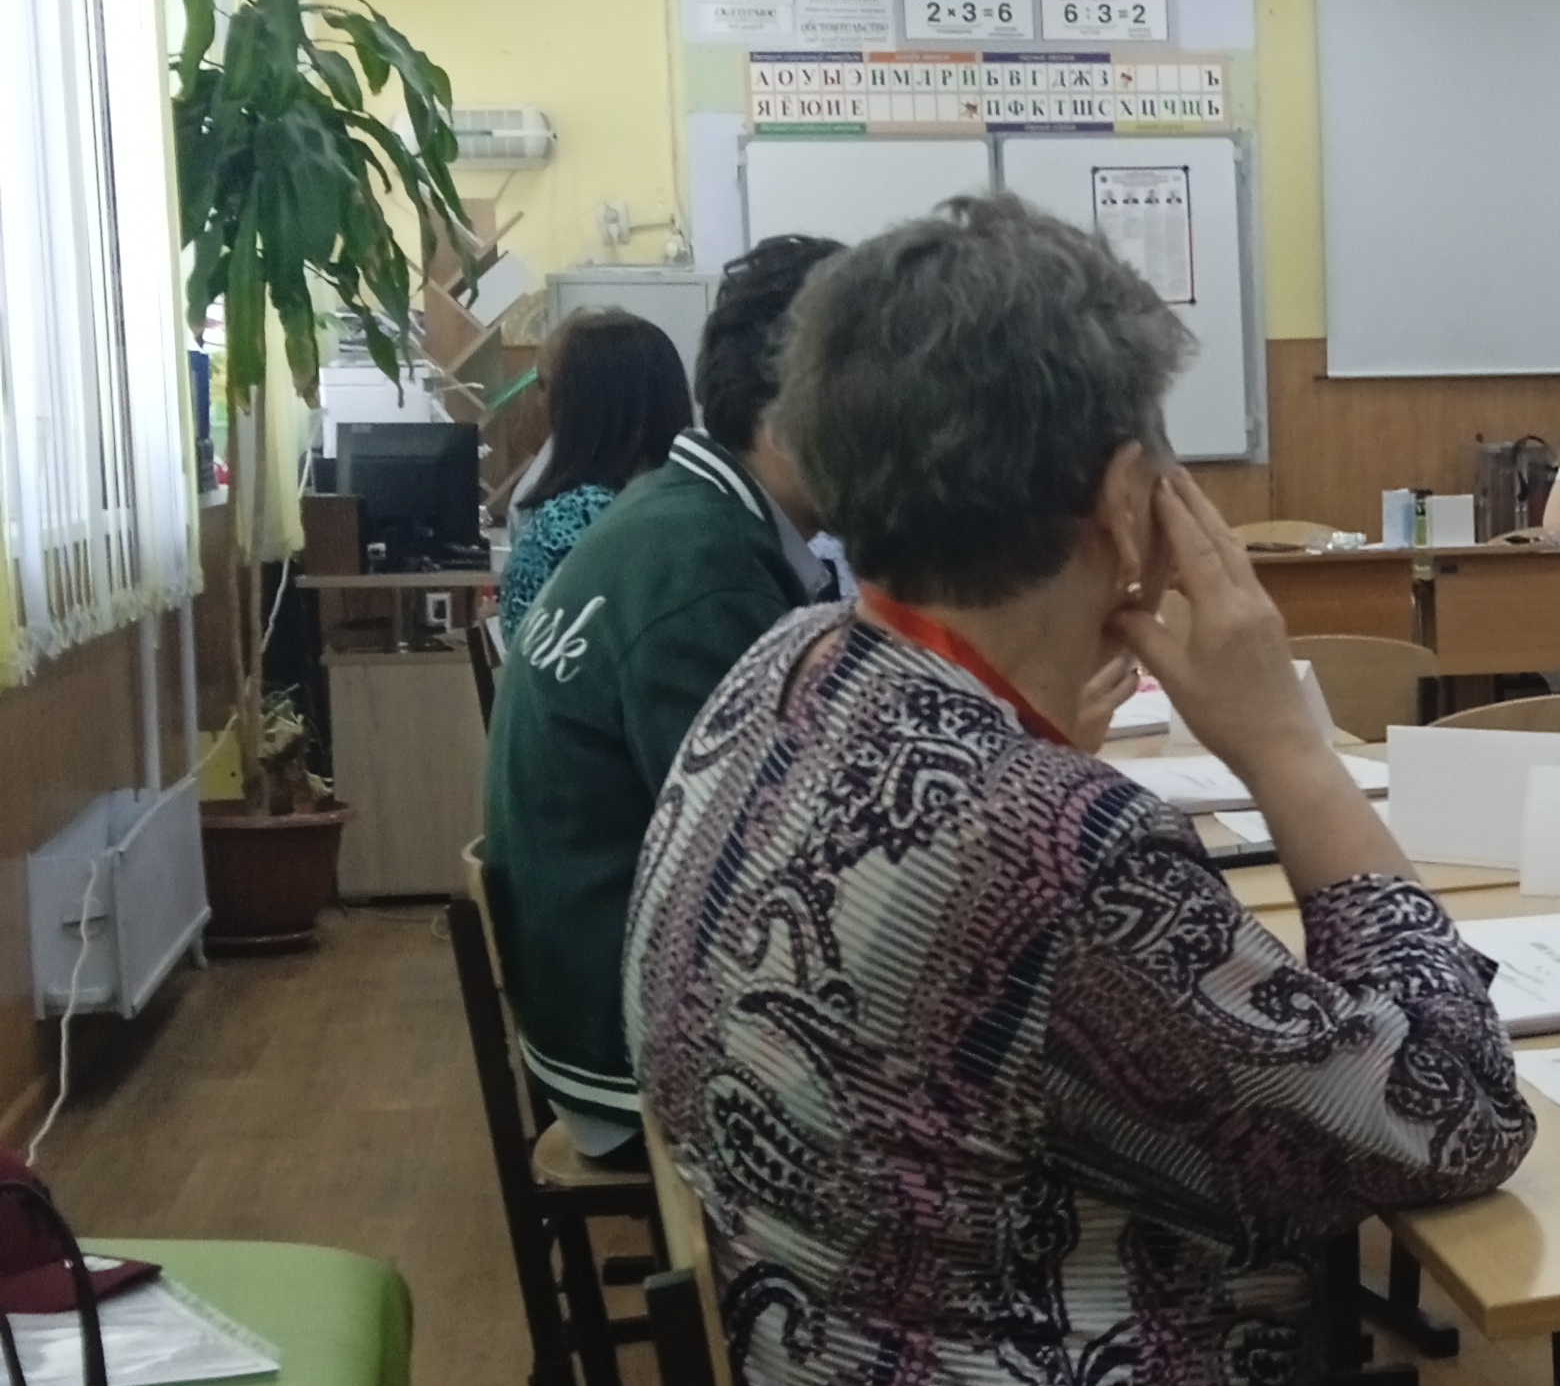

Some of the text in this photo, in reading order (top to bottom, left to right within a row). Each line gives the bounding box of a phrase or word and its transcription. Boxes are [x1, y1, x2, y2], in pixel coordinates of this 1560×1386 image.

[926, 1, 941, 23] 2
[962, 2, 977, 23] 3
[998, 2, 1013, 23] 6
[1064, 3, 1078, 24] 6
[1097, 3, 1112, 24] 3
[1132, 4, 1146, 24] 2
